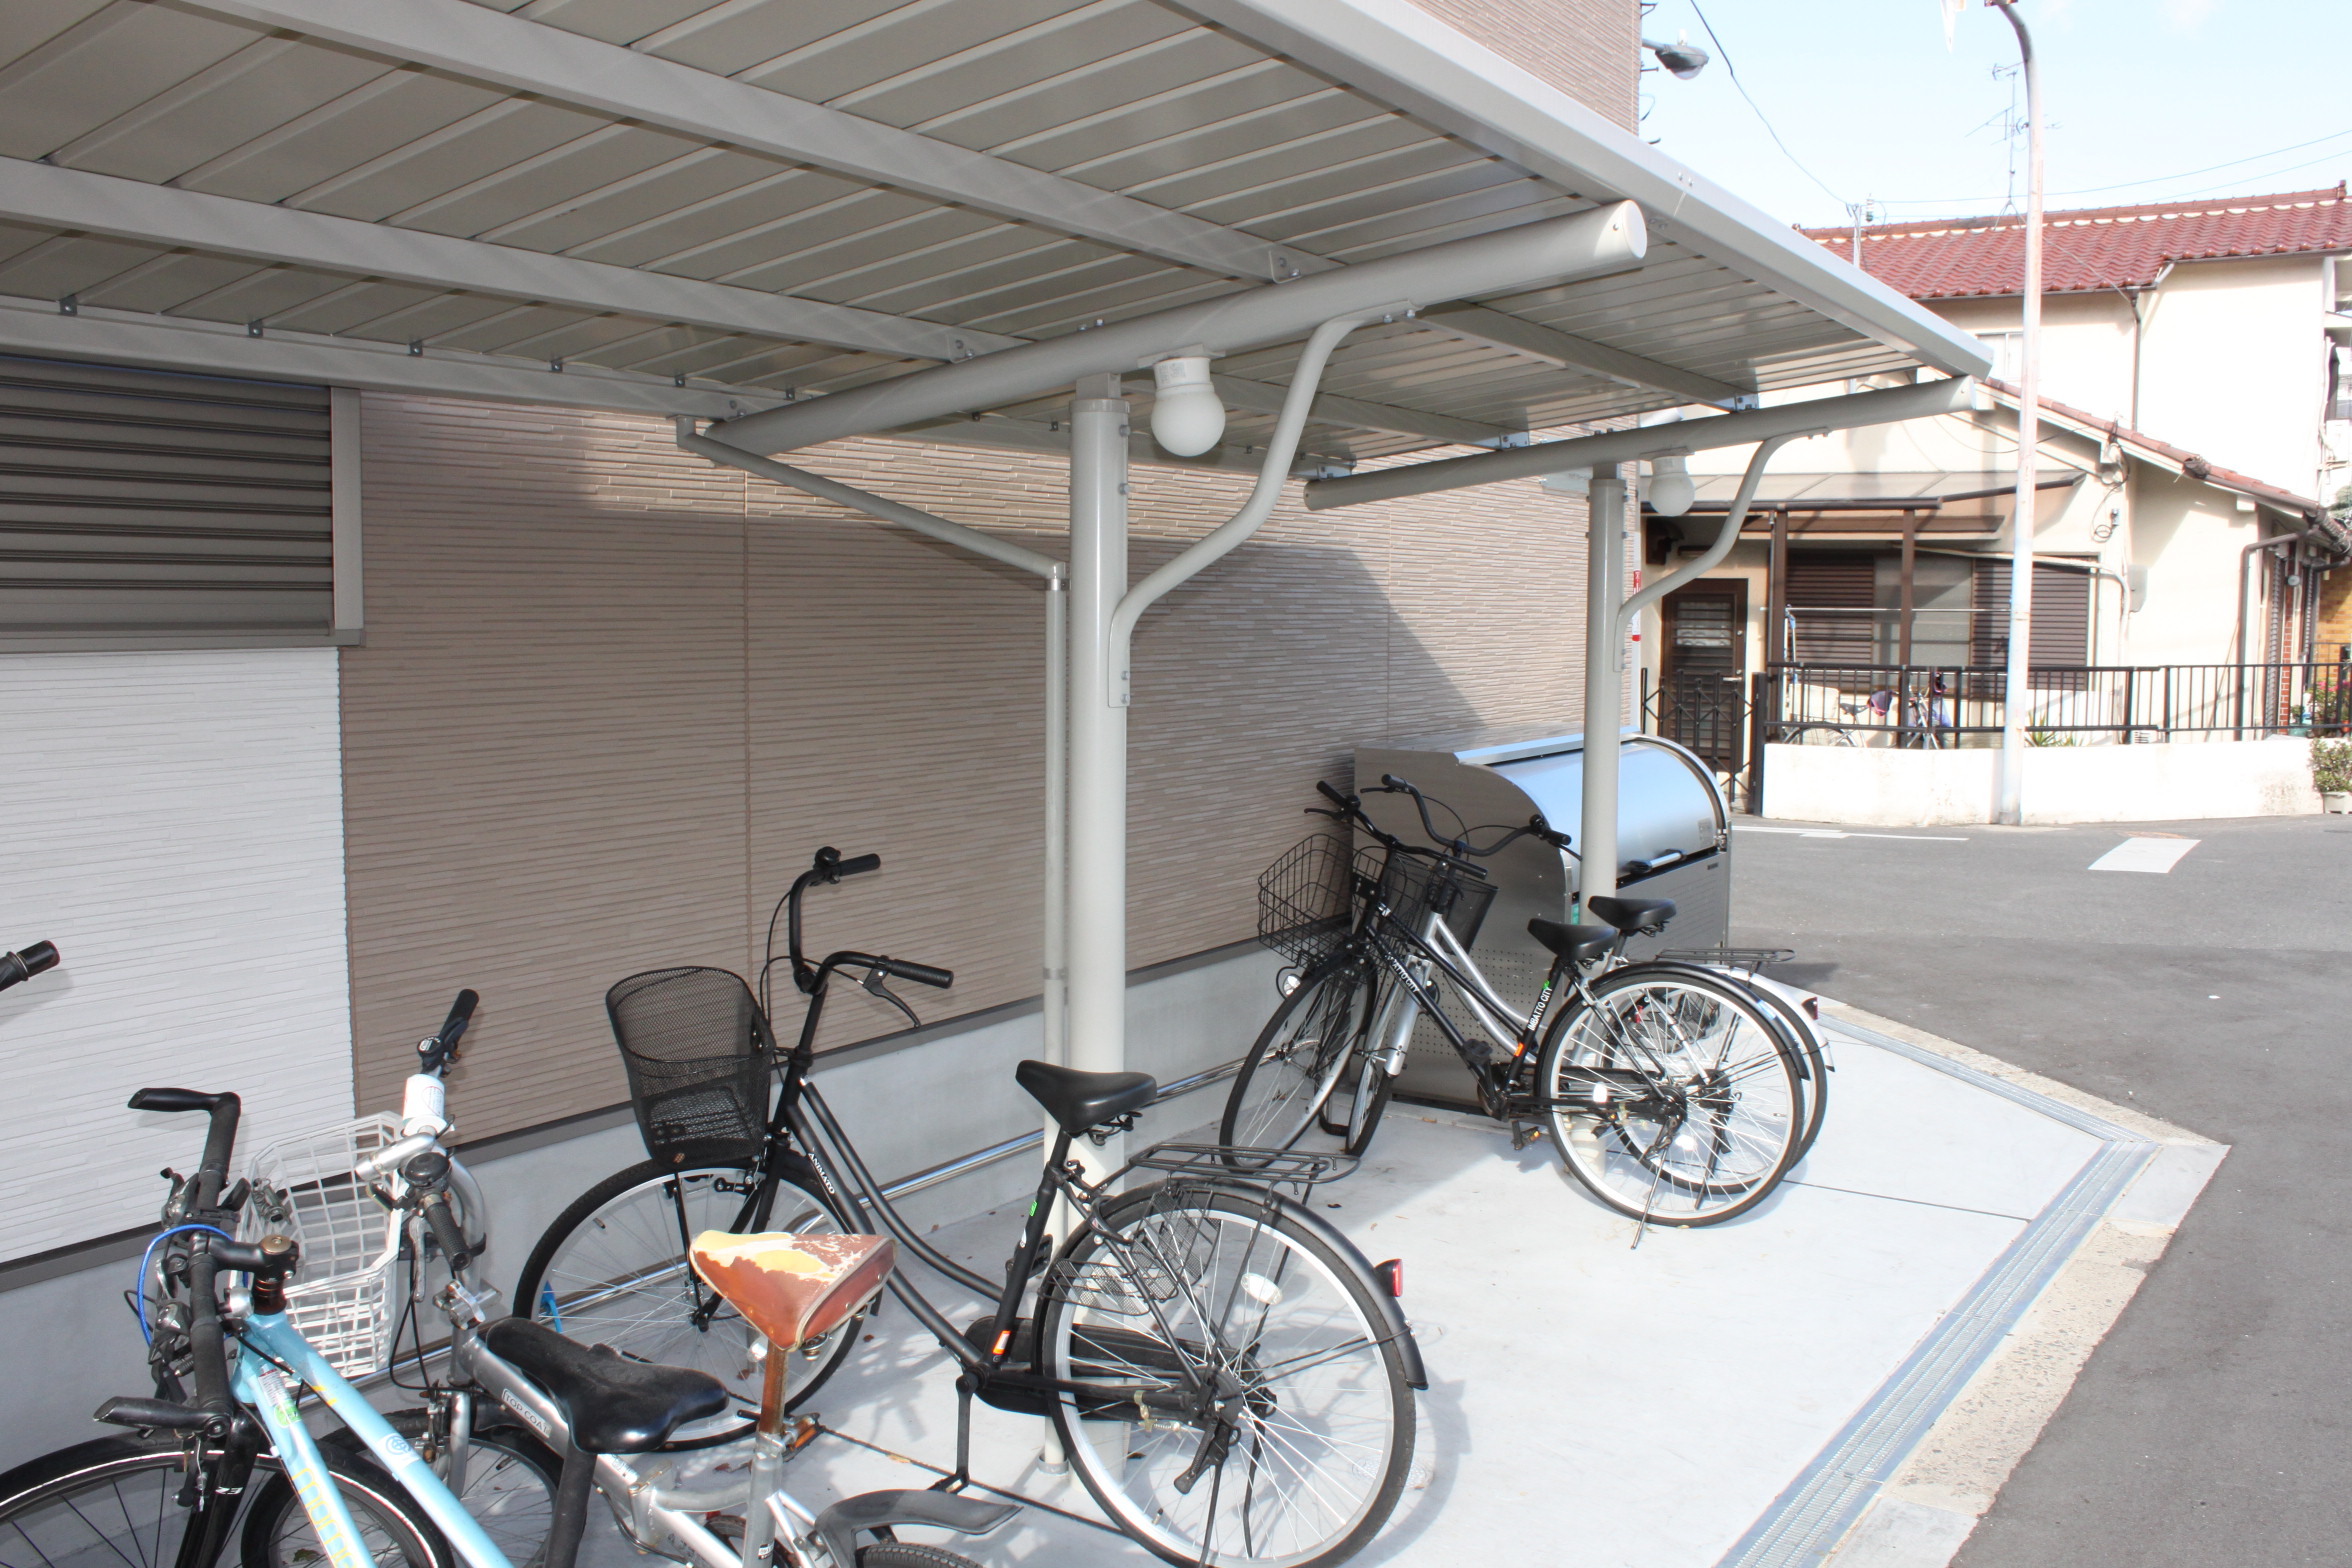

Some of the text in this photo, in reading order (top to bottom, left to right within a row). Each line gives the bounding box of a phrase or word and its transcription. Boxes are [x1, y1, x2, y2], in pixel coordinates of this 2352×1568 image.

[1405, 977, 1420, 993] CITY
[1540, 987, 1553, 1002] CITY
[808, 1153, 835, 1195] ANIMATO
[504, 1393, 549, 1434] TOP COAT
